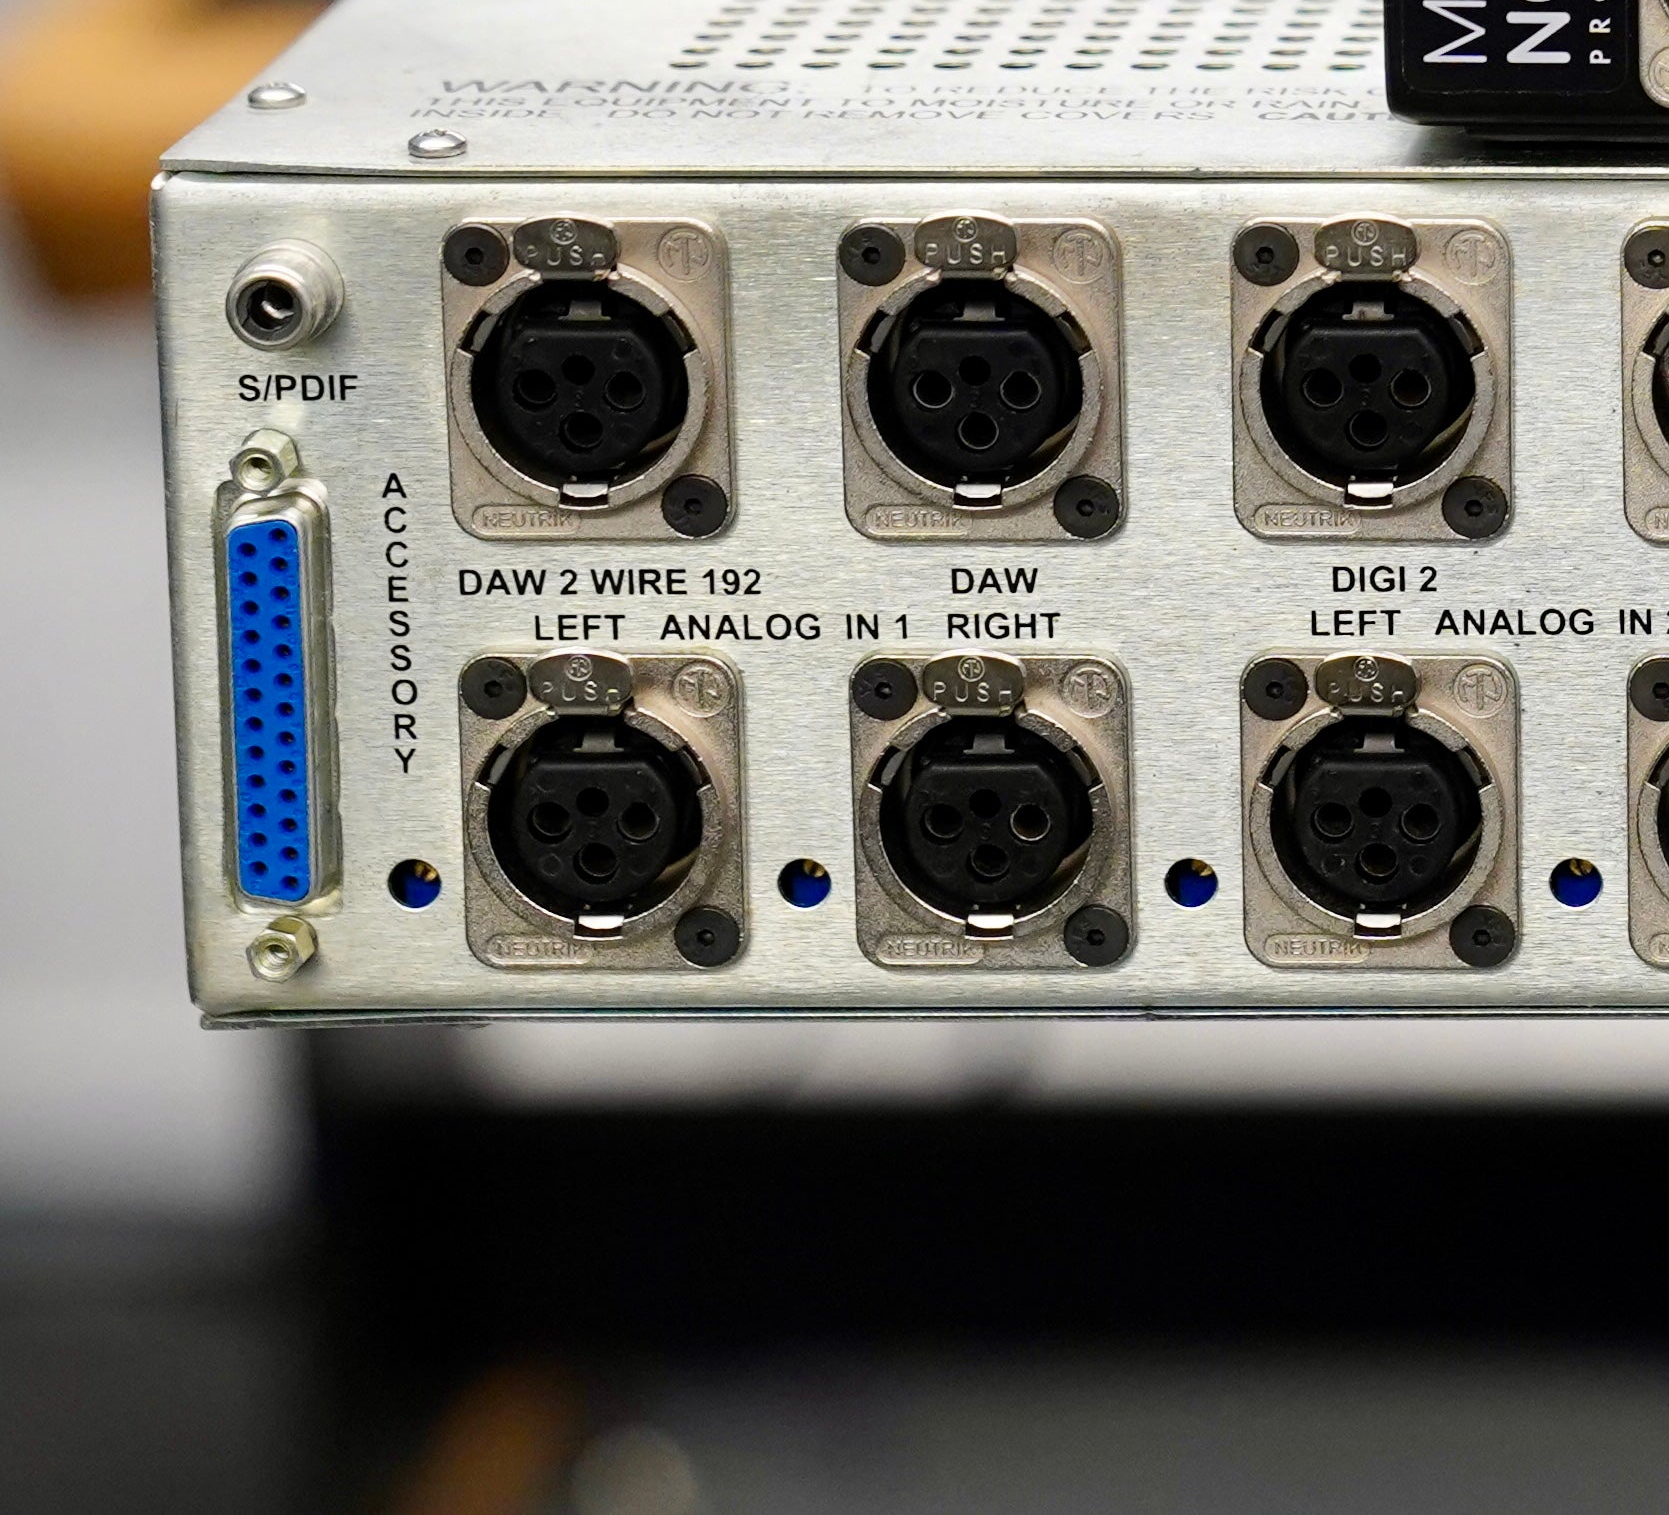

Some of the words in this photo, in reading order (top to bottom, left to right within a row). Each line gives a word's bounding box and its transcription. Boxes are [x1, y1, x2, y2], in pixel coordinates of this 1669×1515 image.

[1246, 87, 1347, 96] RISK
[429, 97, 526, 107] THIS
[542, 97, 815, 107] EQUIPMENT
[841, 98, 896, 107] TO
[909, 98, 1150, 109] MOISTURE
[1169, 99, 1236, 109] OR
[607, 109, 678, 119] DO
[690, 109, 793, 119] NOT
[801, 110, 1006, 120] REMOVE
[926, 243, 1007, 265] PUSH
[1326, 245, 1406, 266] PUSH
[238, 374, 358, 402] S/PDIF
[482, 510, 572, 527] NEUTRIK
[874, 509, 963, 527] NEUTRIK
[1264, 510, 1355, 527] NEUTRIK
[458, 569, 547, 596] DAW
[560, 569, 578, 596] 2
[590, 568, 688, 595] WIRE
[702, 568, 762, 596] 192
[951, 567, 1038, 594] DAW
[1332, 565, 1406, 593] DIGI
[1419, 565, 1437, 592] 2
[381, 472, 418, 774] ACCESSORY
[534, 614, 626, 641] LEFT
[660, 613, 821, 641] ANALOG
[846, 613, 879, 640] IN
[895, 613, 908, 640] 1
[947, 612, 1061, 640] RIGHT
[1311, 609, 1401, 637] LEFT
[1434, 608, 1594, 636] ANALOG
[1619, 608, 1652, 635] IN
[933, 682, 1012, 703] PUSH
[496, 940, 585, 957] NEUTRIK
[887, 940, 976, 957] NEUTRIK
[1273, 938, 1362, 956] NEUTRIK
